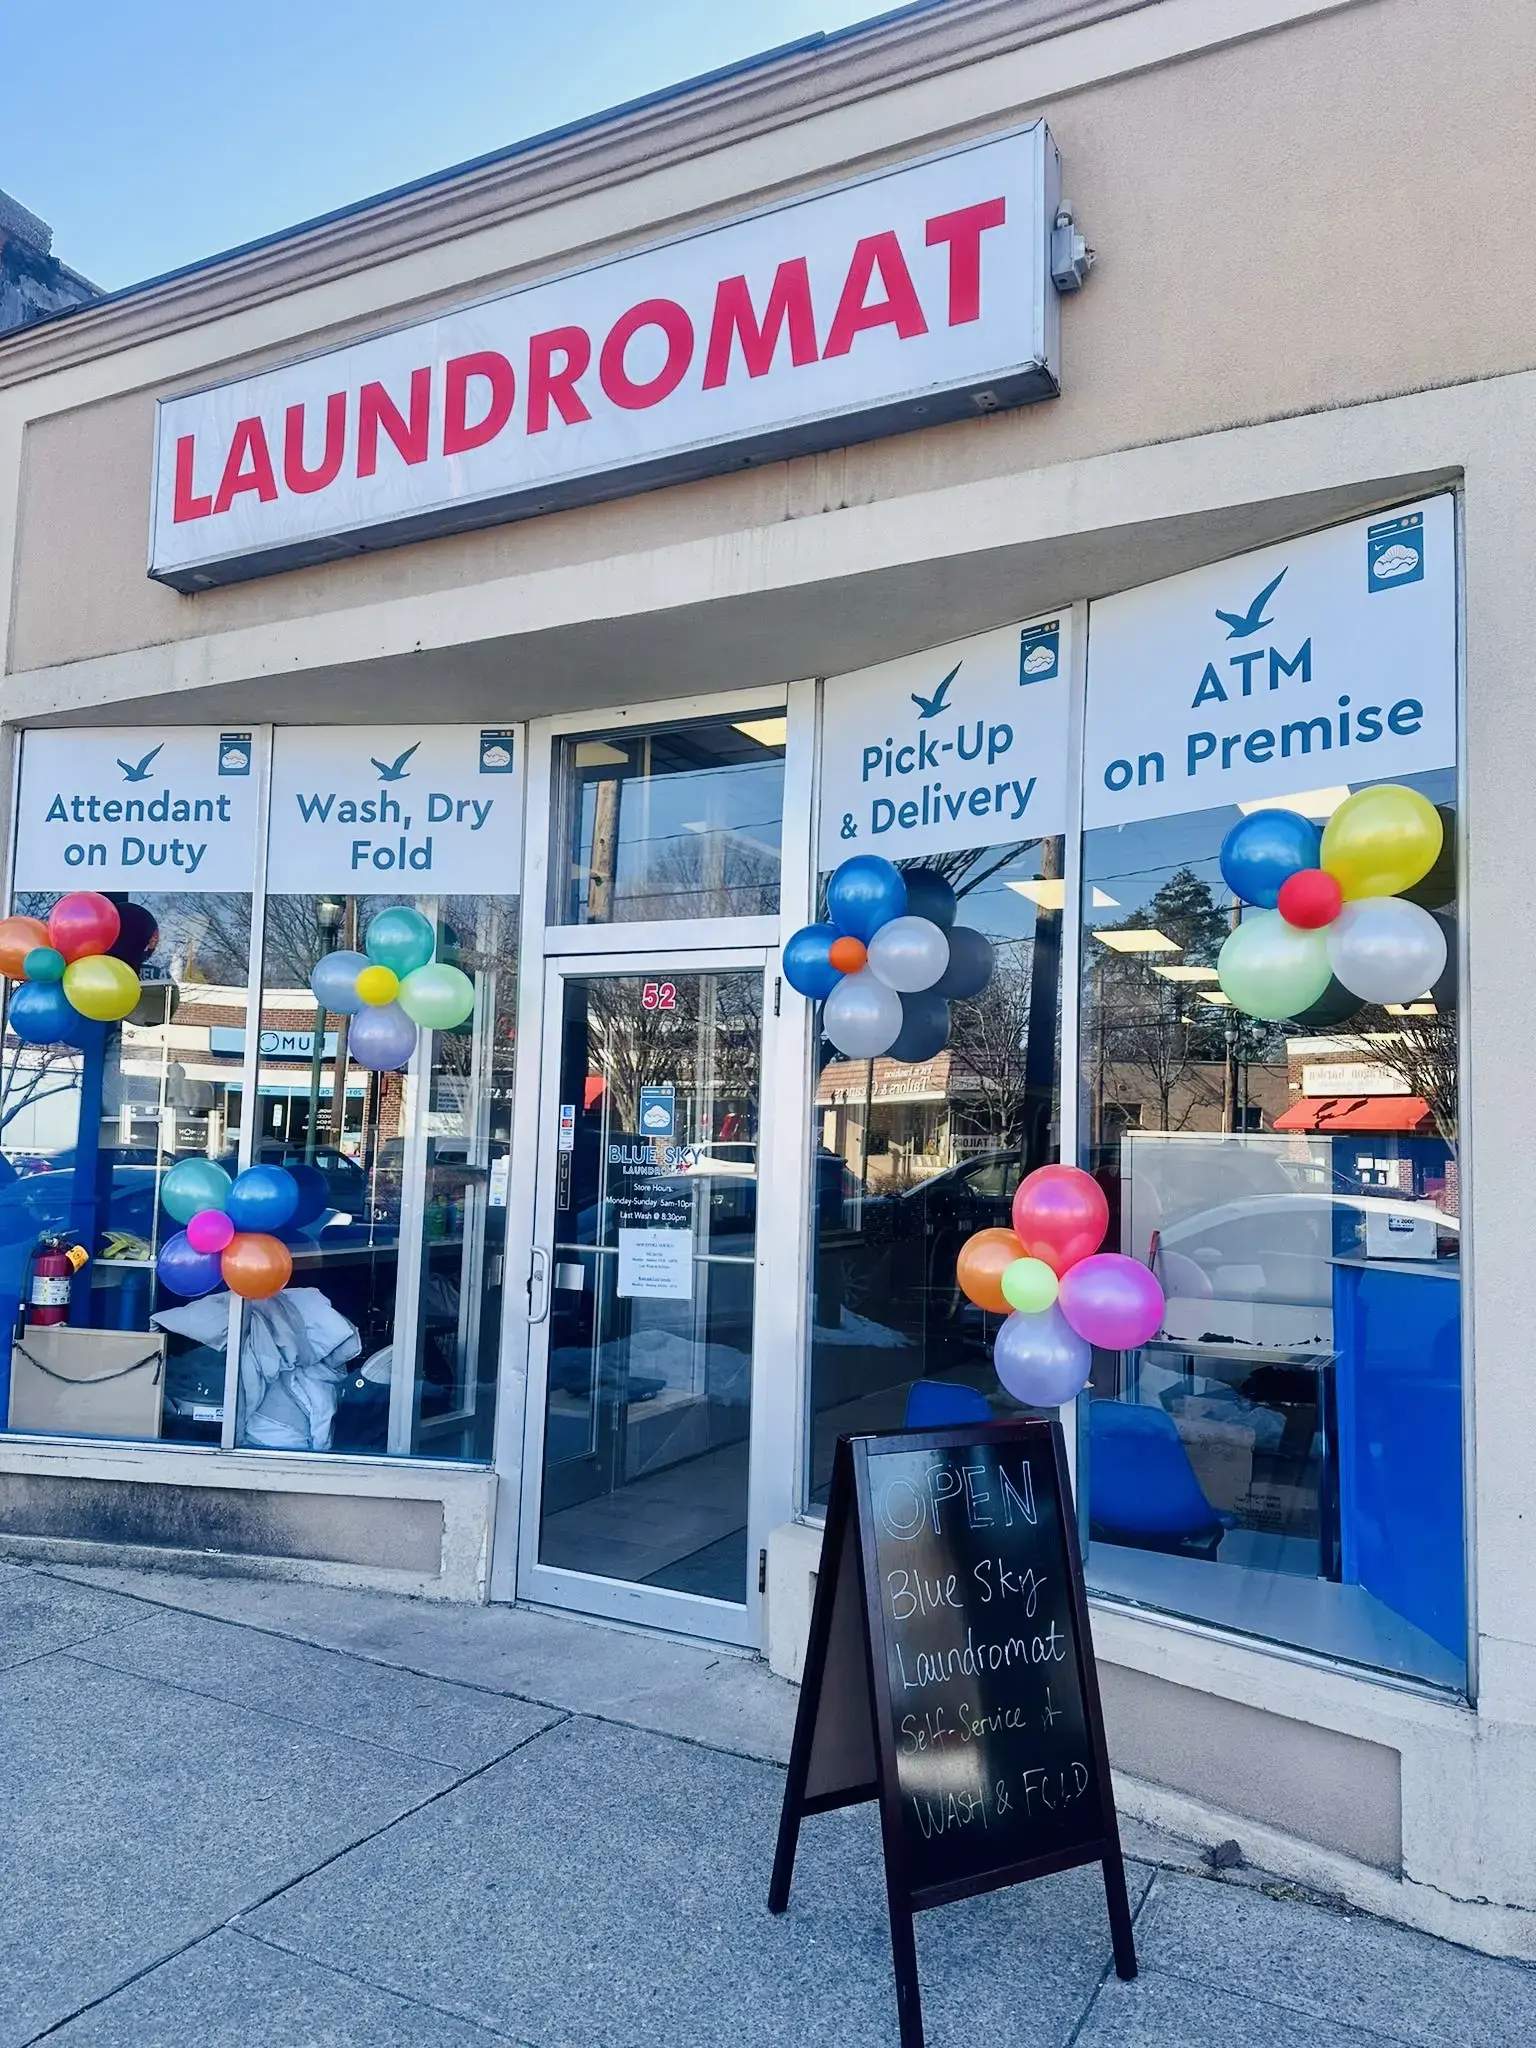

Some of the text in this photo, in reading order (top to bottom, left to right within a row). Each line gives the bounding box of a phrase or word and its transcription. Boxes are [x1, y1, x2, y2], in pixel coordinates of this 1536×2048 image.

[173, 196, 1006, 524] LAUNDROMAT
[1191, 637, 1312, 709] ATM
[862, 719, 1013, 781] Pick-Up
[1104, 695, 1423, 791] on Premise
[45, 789, 231, 823] Attendant
[296, 789, 494, 831] Wash, Dry
[840, 776, 1037, 839] & Delivery
[63, 837, 207, 873] on Duty
[352, 837, 432, 870] Fold
[641, 983, 676, 1010] 52
[560, 1153, 568, 1207] PULL
[608, 1144, 702, 1165] BLUE SKY
[606, 1196, 696, 1210] Monday-Sunday 5am-10pm
[633, 1183, 651, 1191] Store
[620, 1211, 633, 1219] Last
[661, 1213, 686, 1222] 8:30pm
[879, 1460, 1039, 1541] OPEN
[887, 1558, 1048, 1620] Blue Sky
[895, 1620, 1066, 1690] Laundromat
[900, 1703, 1026, 1757] Self-Service
[912, 1789, 989, 1840] WASH
[996, 1780, 1013, 1813] &
